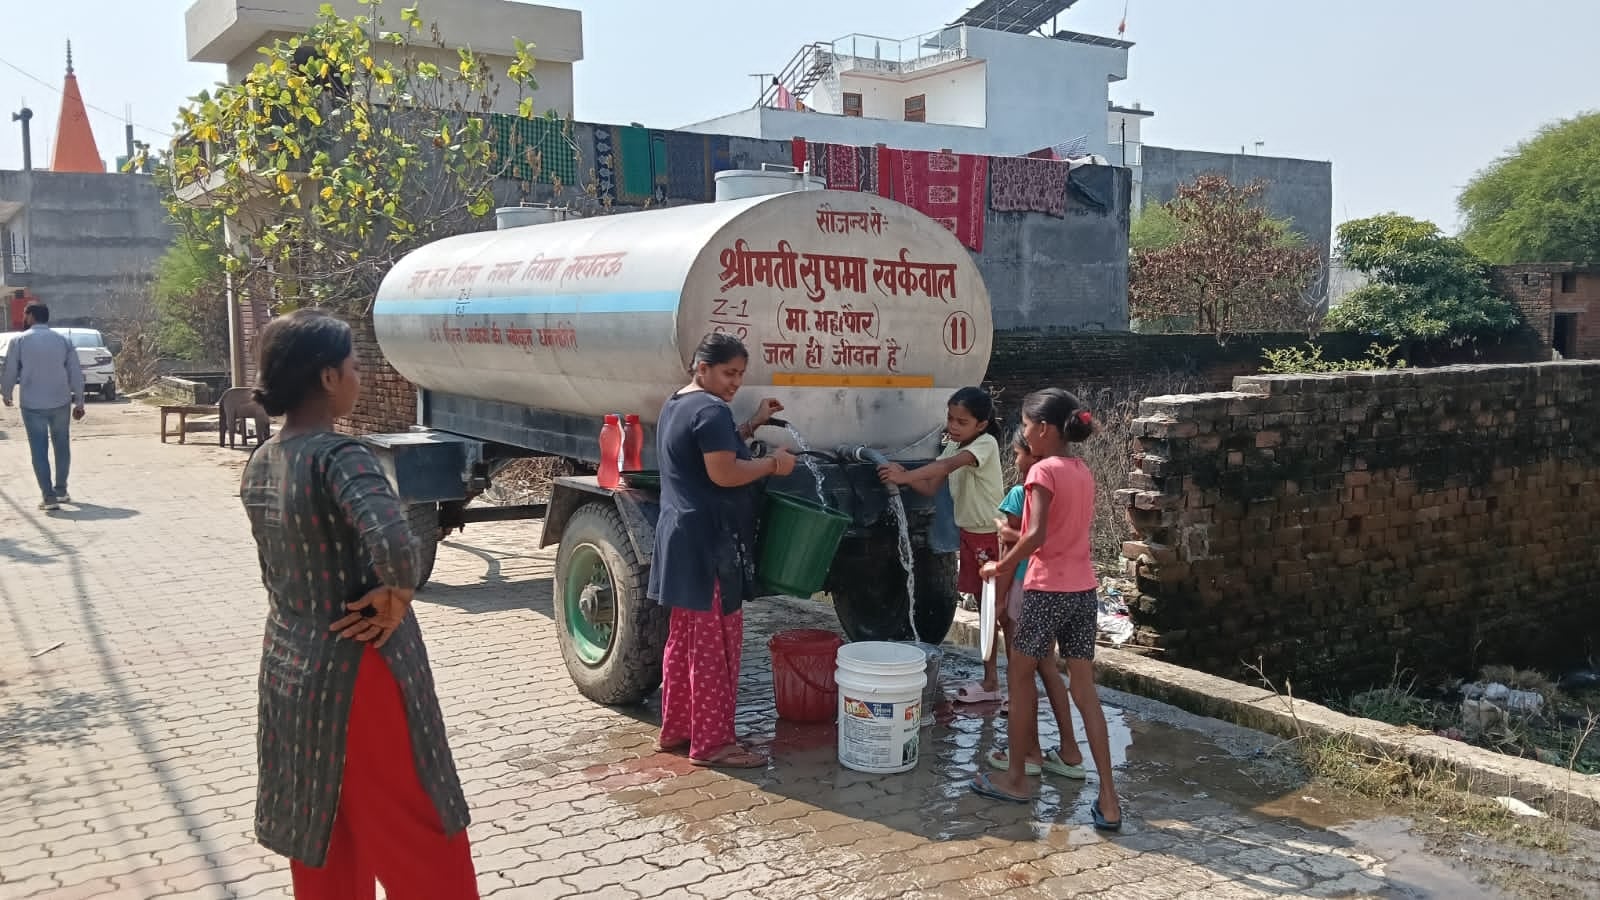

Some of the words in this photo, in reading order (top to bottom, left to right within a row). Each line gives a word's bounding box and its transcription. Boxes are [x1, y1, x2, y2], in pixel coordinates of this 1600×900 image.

[816, 203, 868, 233] सौजन्य
[719, 239, 797, 292] श्रीमती
[800, 252, 868, 302] सुषमा
[872, 248, 957, 303] खर्कवाल
[711, 299, 749, 317] Z-1
[950, 316, 967, 350] 11
[763, 343, 797, 368] जल
[831, 338, 882, 367] जीवन
